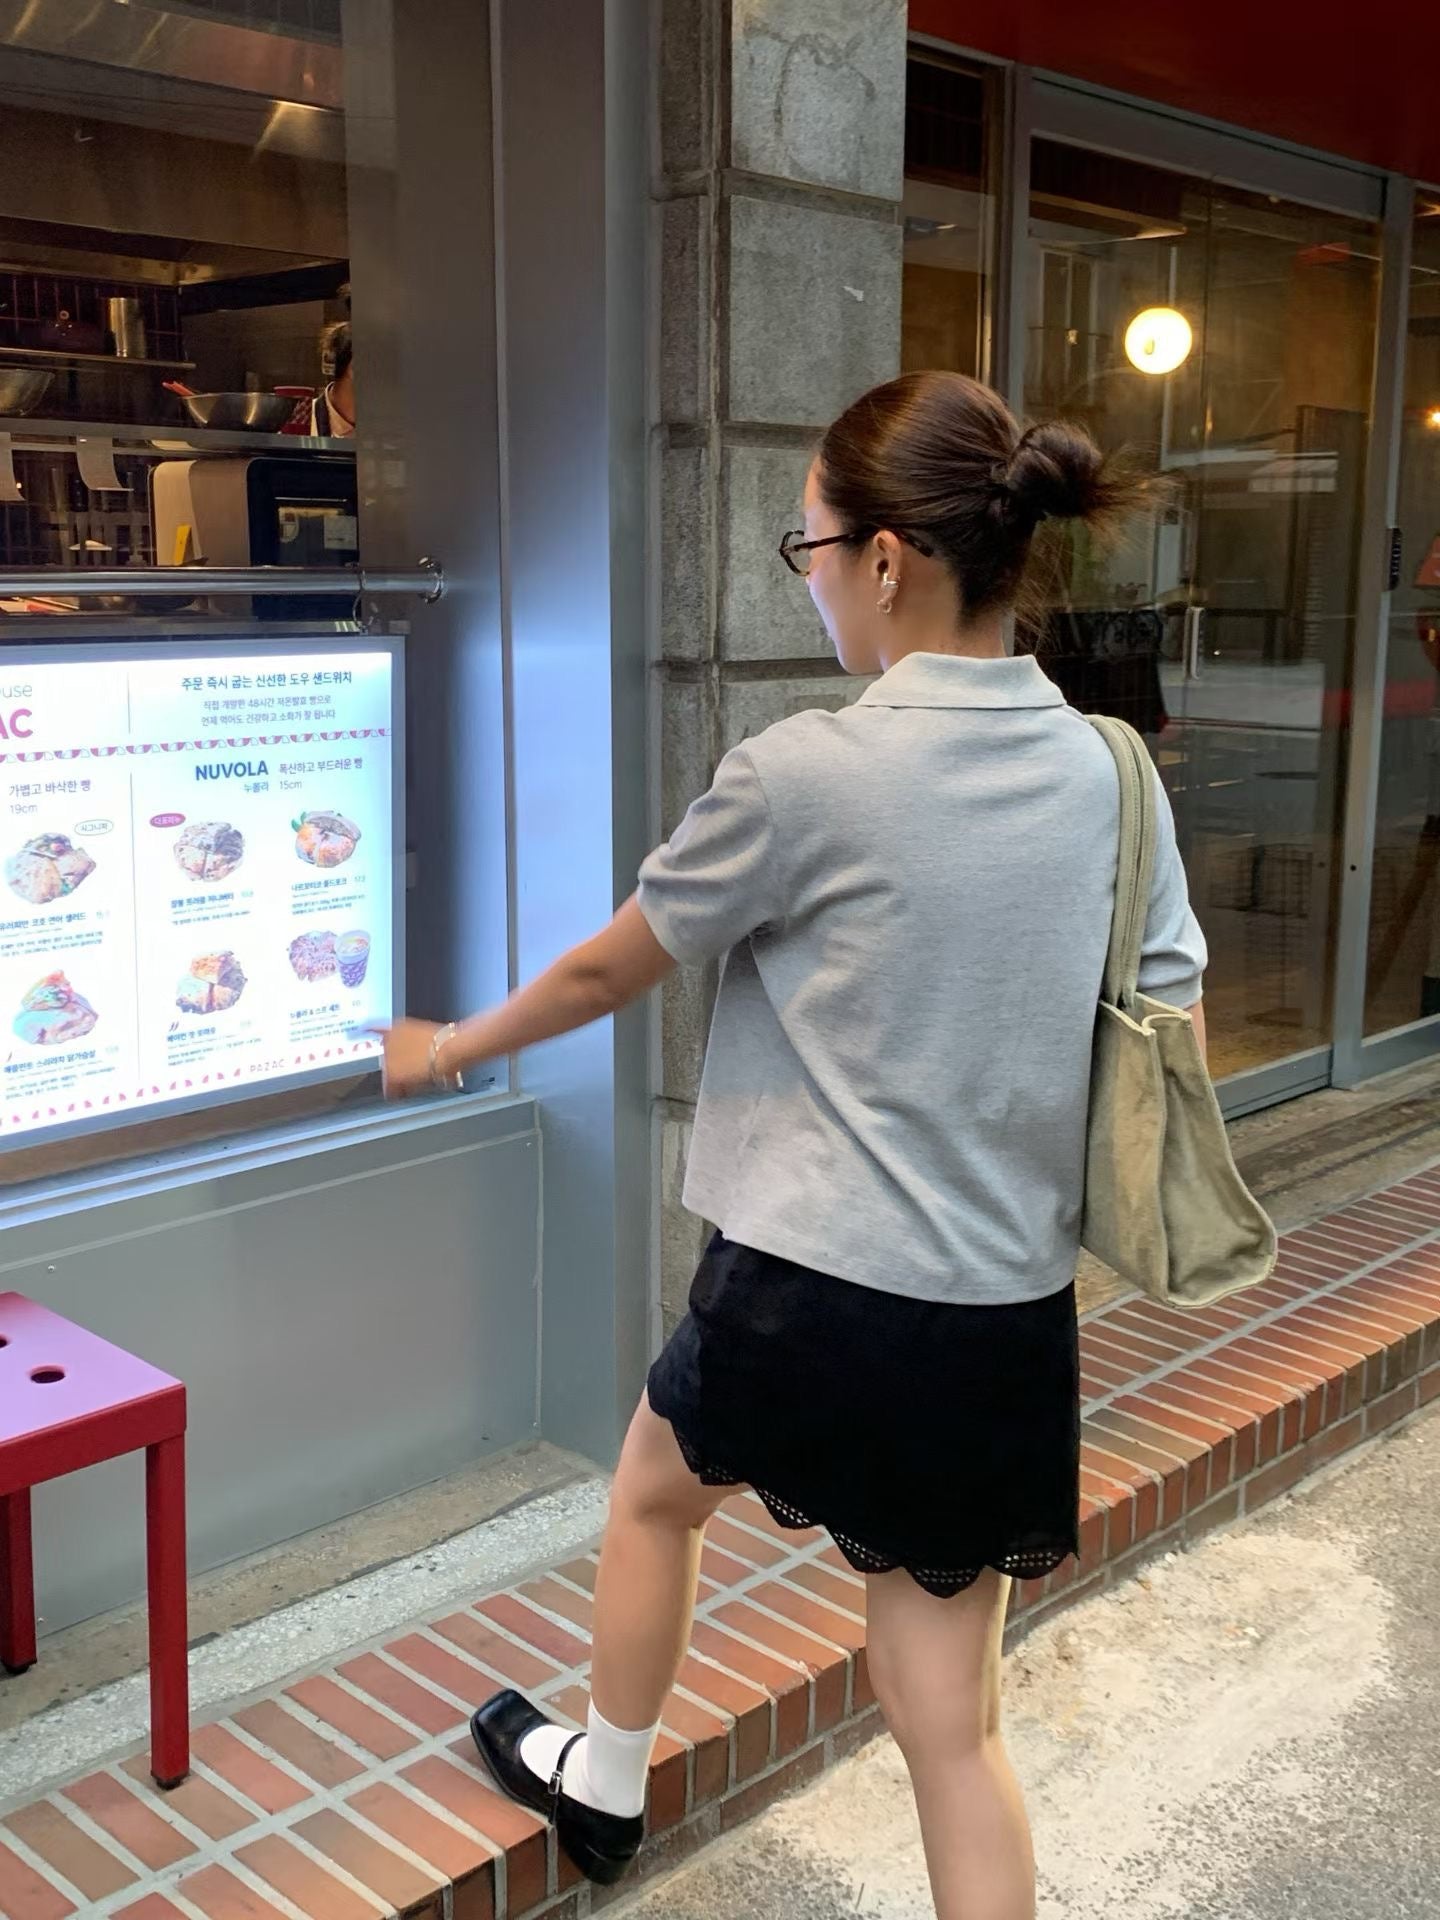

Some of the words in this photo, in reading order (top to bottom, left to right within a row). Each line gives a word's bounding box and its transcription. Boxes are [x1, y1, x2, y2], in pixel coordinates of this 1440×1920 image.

[182, 676, 203, 690] 주문
[207, 675, 228, 689] 즉시
[232, 674, 252, 688] 굽는
[256, 673, 286, 687] 신선한
[290, 672, 309, 685] 도우
[313, 671, 352, 685] 샌드위치
[0, 684, 32, 698] use
[204, 699, 219, 710] 직접
[248, 697, 274, 708] 48시간
[309, 694, 331, 705] 빵으로
[201, 716, 217, 727] 언제
[220, 714, 242, 725] 먹어도
[246, 712, 277, 724] 건강하고
[279, 711, 302, 721] 소화가
[314, 709, 335, 720] 됩니다
[195, 760, 269, 781] NUVOLA
[318, 759, 352, 772] 부드러운
[354, 757, 363, 769] 빵
[9, 783, 41, 797] 가볍고
[45, 780, 77, 794] 바삭한
[81, 779, 91, 791] 빵
[243, 783, 269, 793] 누볼라
[280, 780, 302, 790] 15cm
[10, 804, 38, 815] 19cm
